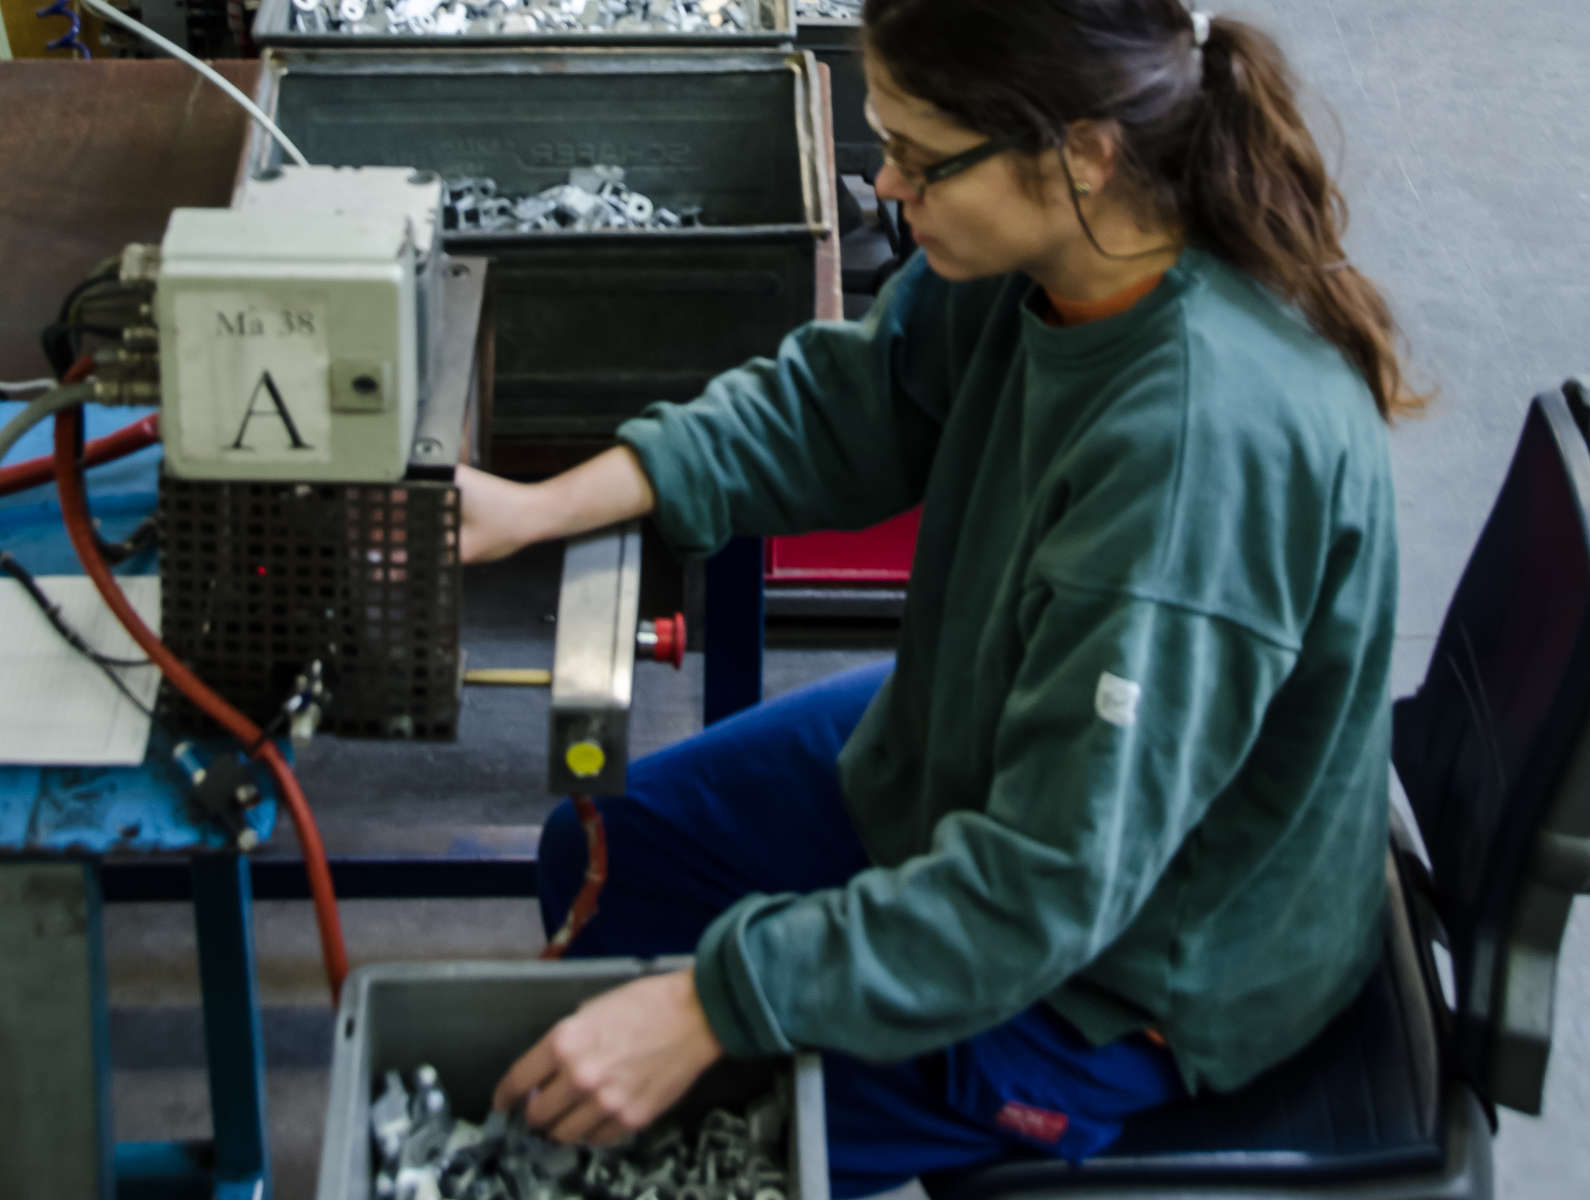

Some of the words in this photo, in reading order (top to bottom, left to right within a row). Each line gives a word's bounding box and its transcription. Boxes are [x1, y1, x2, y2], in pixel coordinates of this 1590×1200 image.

[215, 311, 264, 337] Ma
[277, 309, 316, 337] 38
[221, 368, 315, 451] A
